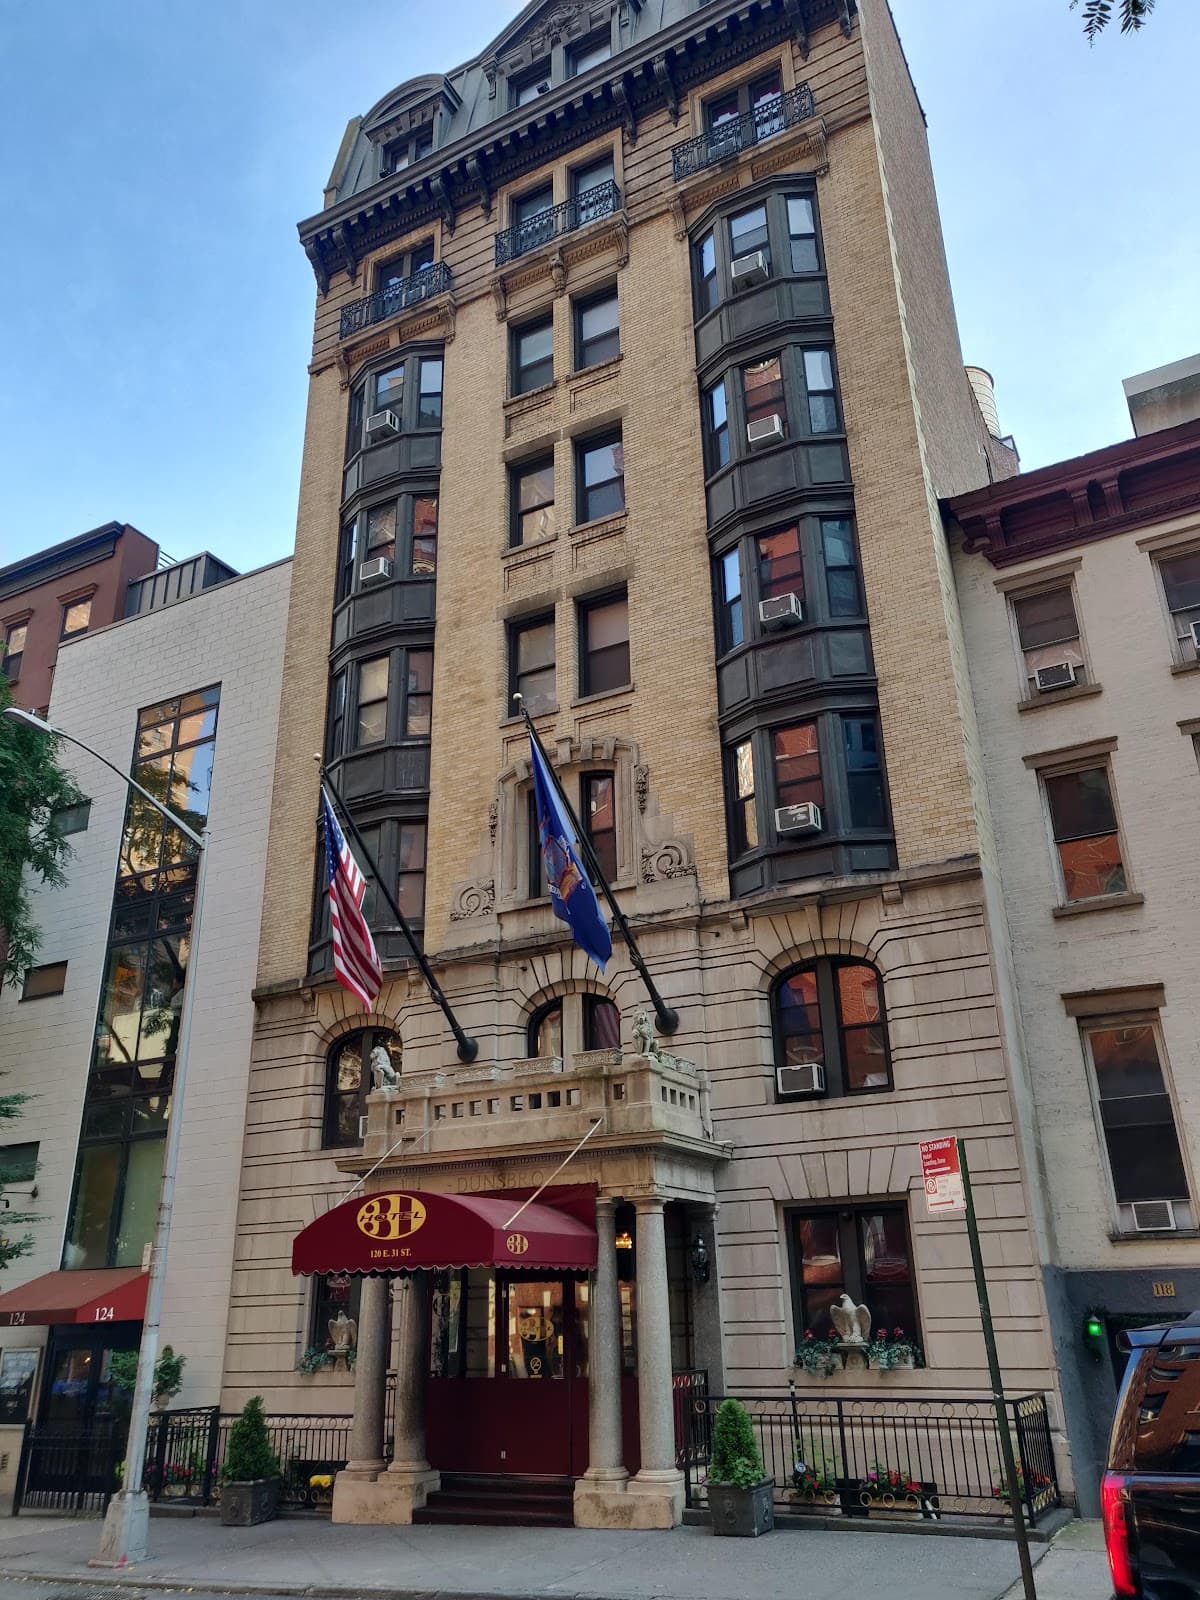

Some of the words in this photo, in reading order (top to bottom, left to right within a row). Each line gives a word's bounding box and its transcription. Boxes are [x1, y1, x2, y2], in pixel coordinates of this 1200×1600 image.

[929, 1140, 951, 1151] STANDING
[360, 1210, 424, 1222] HOTEL
[370, 1250, 381, 1258] 120
[383, 1249, 390, 1257] E.
[391, 1249, 399, 1257] 31
[400, 1248, 412, 1257] ST.
[1155, 1283, 1173, 1295] 118
[9, 1312, 26, 1325] 124
[95, 1307, 115, 1320] 124
